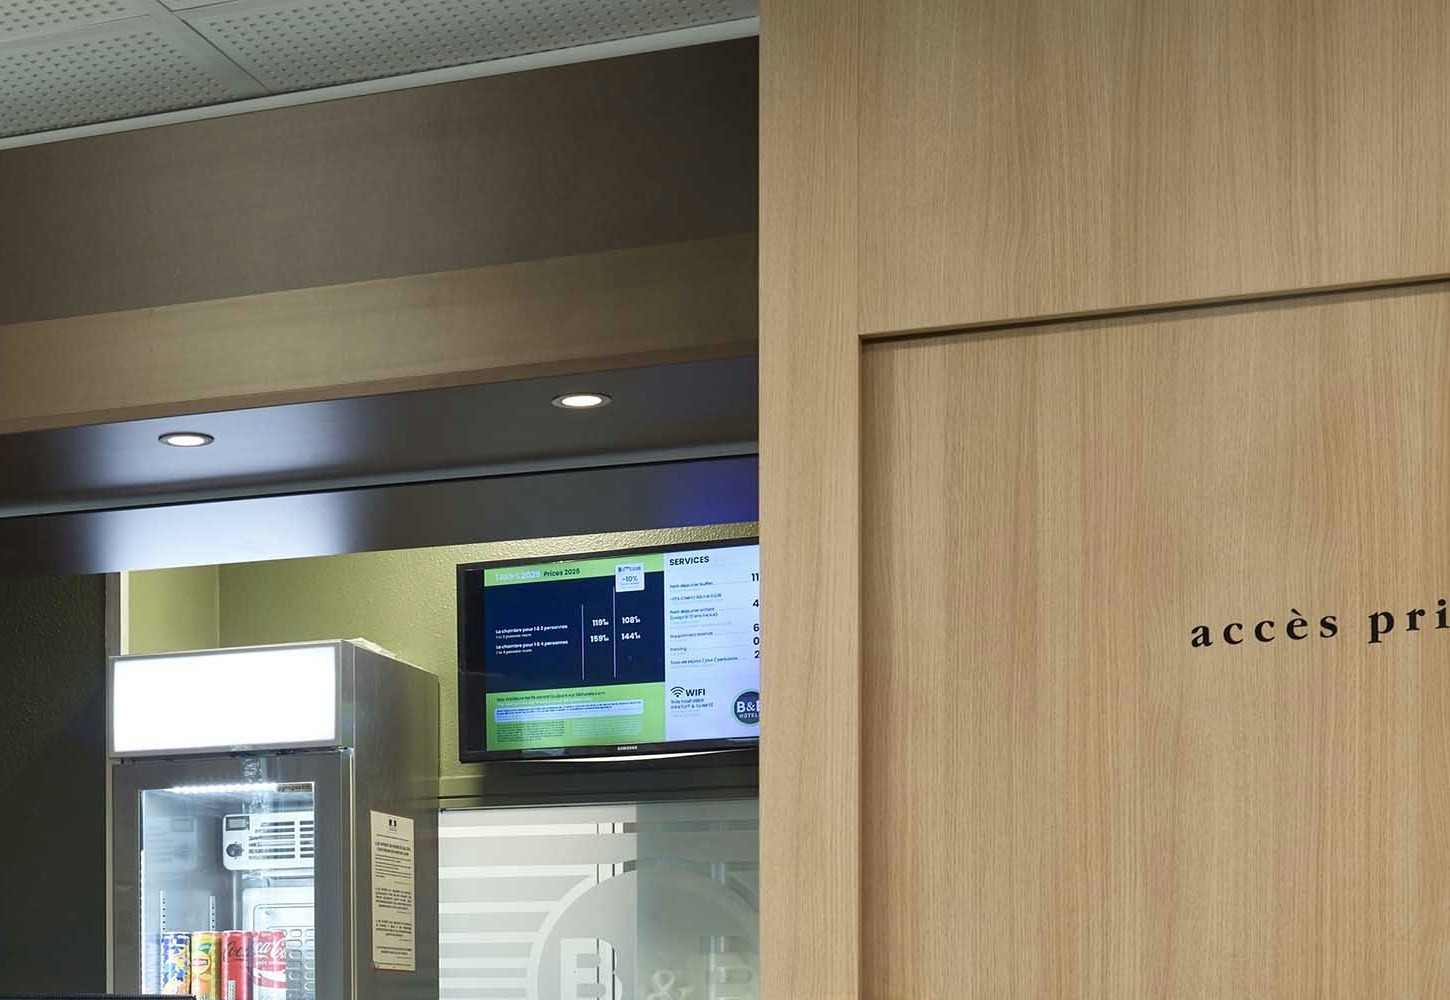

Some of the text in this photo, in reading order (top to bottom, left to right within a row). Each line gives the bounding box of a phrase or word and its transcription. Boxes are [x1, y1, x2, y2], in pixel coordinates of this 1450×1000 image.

[669, 555, 710, 566] SERVICES
[543, 568, 563, 578] Prices
[564, 567, 581, 577] 2025
[752, 598, 759, 608] 4
[753, 623, 760, 633] 6
[1190, 599, 1450, 648] accès pri
[754, 649, 760, 659] 2
[685, 688, 706, 697] WIFI
